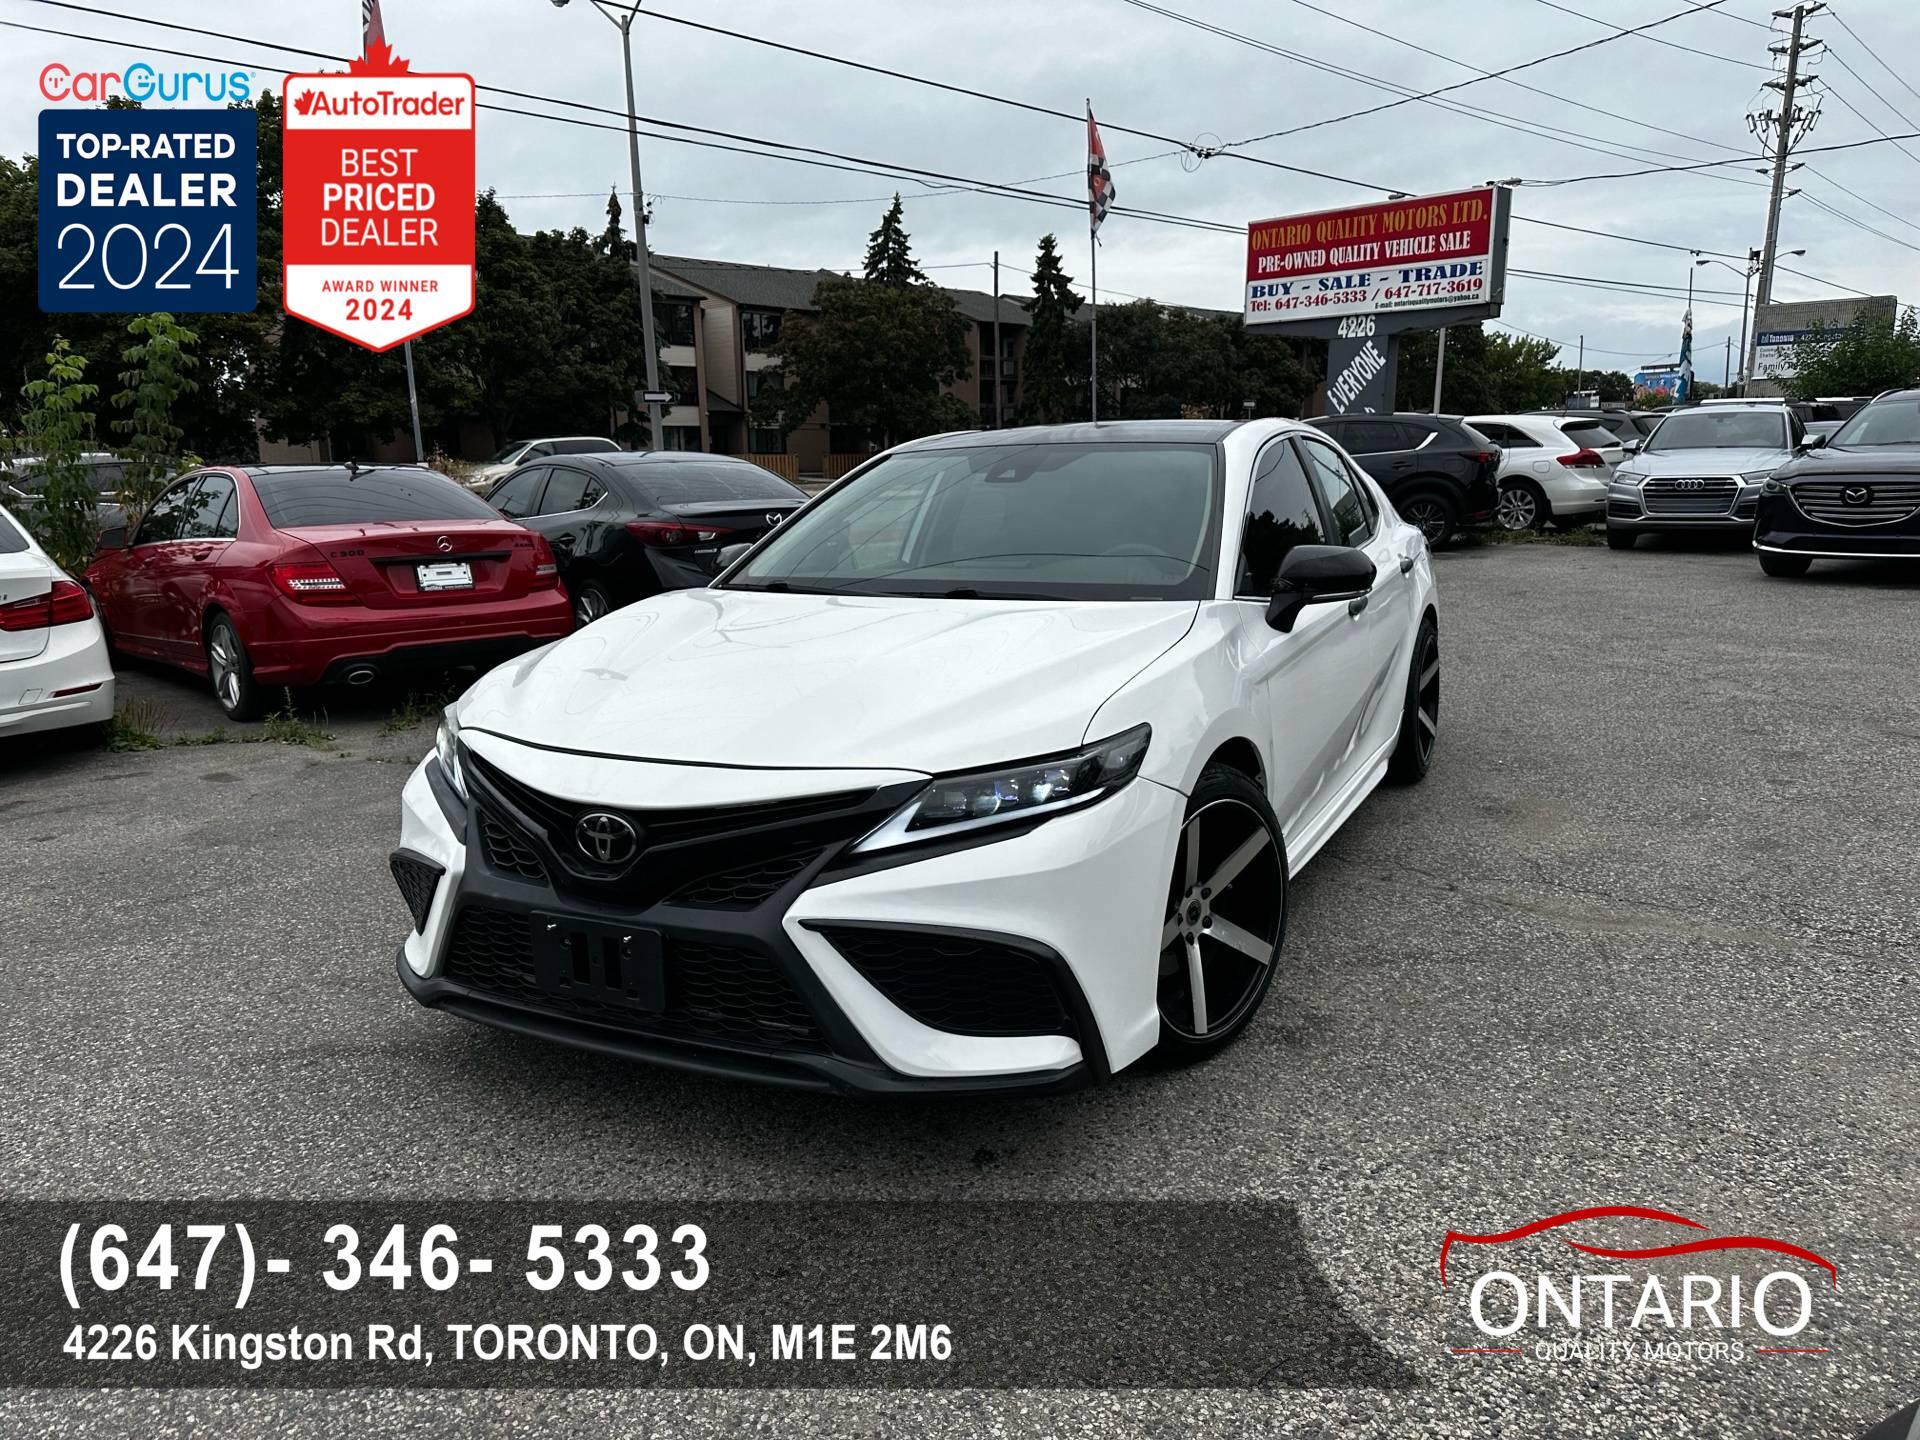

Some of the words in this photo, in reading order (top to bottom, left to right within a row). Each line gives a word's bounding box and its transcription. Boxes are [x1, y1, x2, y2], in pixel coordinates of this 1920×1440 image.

[1252, 223, 1311, 251] ONTARIO
[1316, 214, 1377, 244] QUALITY
[1382, 204, 1447, 234] MOTORS
[1452, 199, 1488, 225] LTD.
[1258, 249, 1326, 274] PRE-OWNED
[1330, 241, 1381, 266] QUALITY
[1384, 235, 1436, 259] VEHICLE
[1440, 230, 1471, 252] SALE
[1250, 300, 1271, 312] Tel:
[1275, 289, 1367, 311] 647-346-5333
[1384, 278, 1483, 300] 647-717-3619
[1251, 282, 1294, 299] BUY
[1318, 273, 1371, 291] SALE
[1398, 261, 1483, 283] TRADE
[1337, 315, 1376, 339] 4226
[1327, 340, 1387, 414] EVERYONE
[1758, 361, 1786, 371] Family
